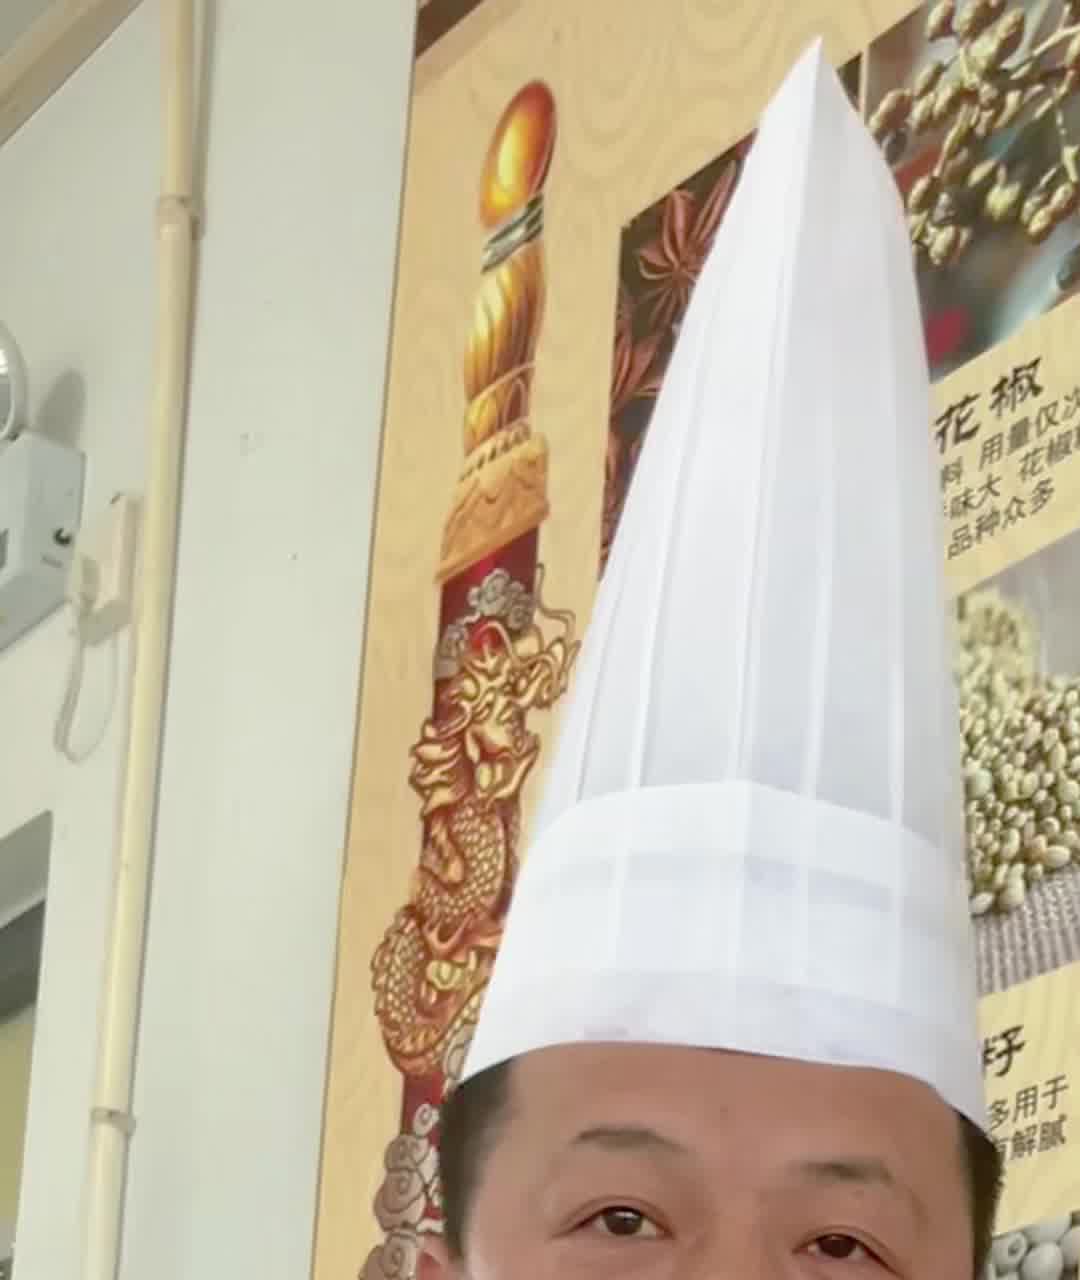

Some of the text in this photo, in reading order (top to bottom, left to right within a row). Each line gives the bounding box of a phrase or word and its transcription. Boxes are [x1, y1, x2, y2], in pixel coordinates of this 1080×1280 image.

[935, 356, 1044, 455] 花椒
[944, 472, 1002, 519] 味大
[947, 477, 1055, 560] 品种众多
[988, 1074, 1070, 1131] 多用于
